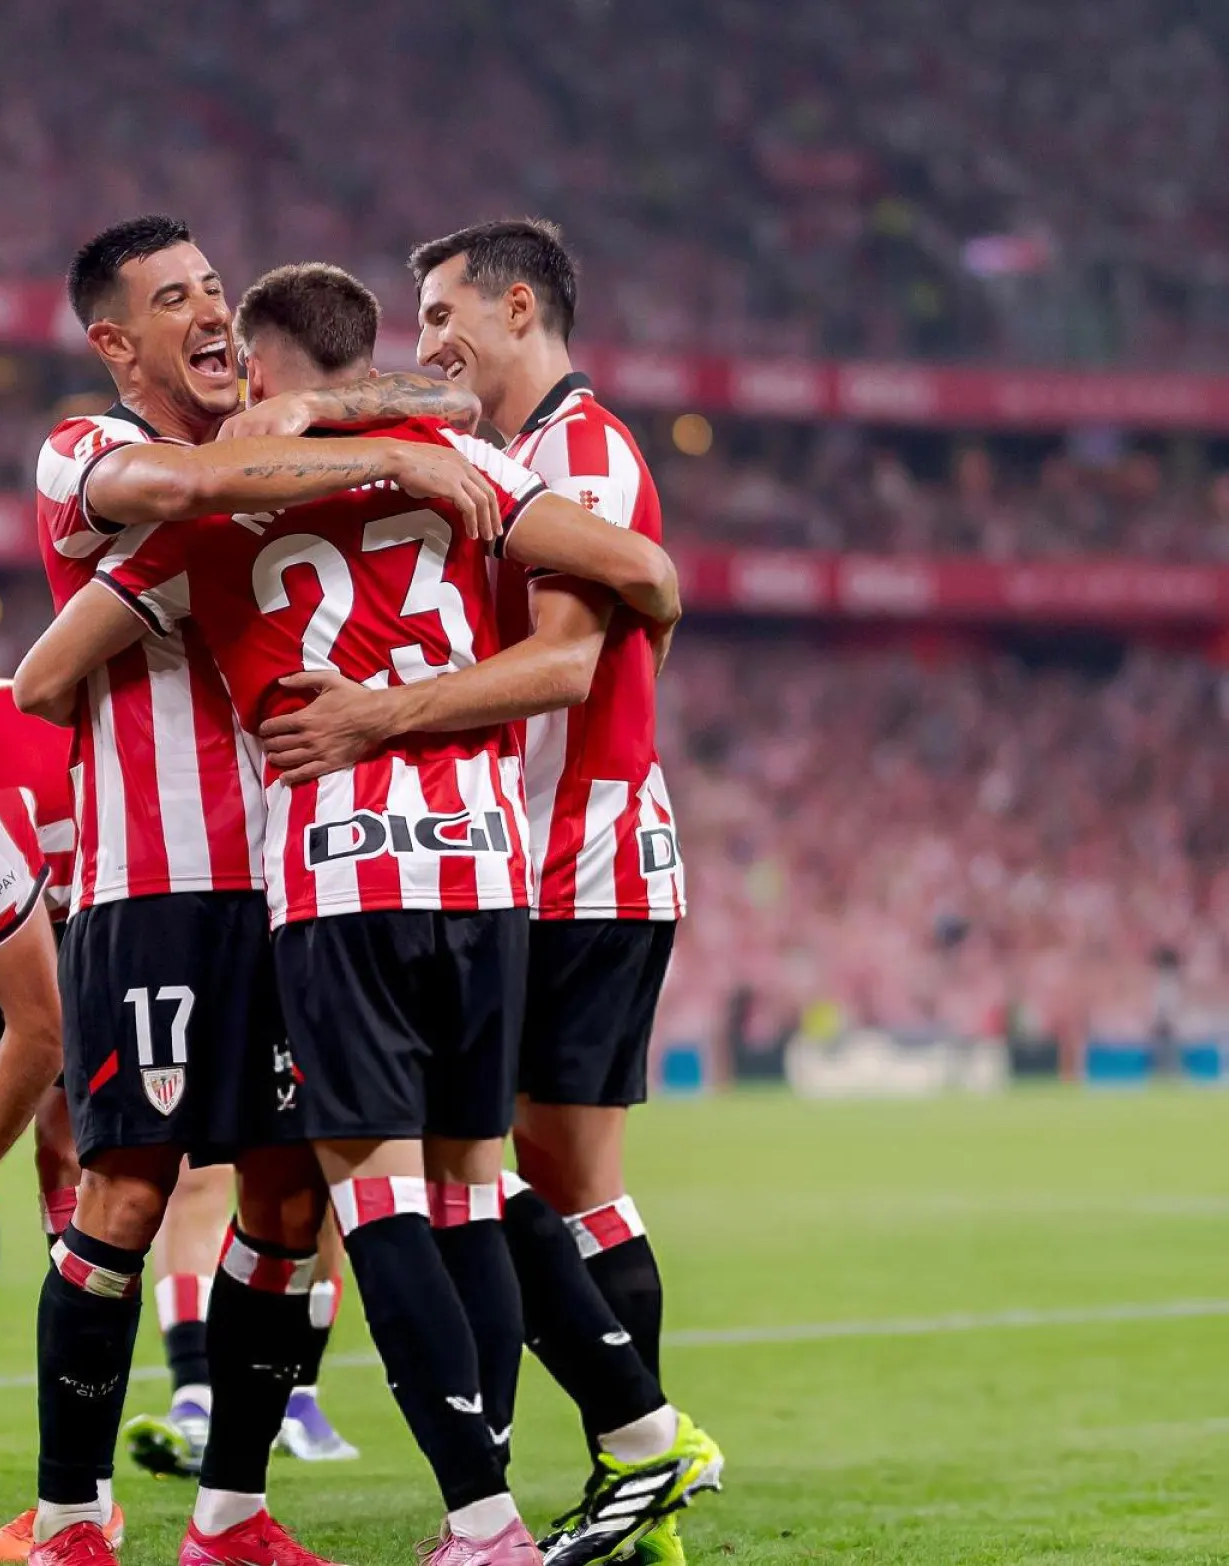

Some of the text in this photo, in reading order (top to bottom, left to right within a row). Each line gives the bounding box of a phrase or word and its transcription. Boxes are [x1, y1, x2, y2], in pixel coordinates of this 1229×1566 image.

[251, 508, 477, 690] 23
[309, 811, 509, 866] DIGI
[123, 985, 196, 1065] 17
